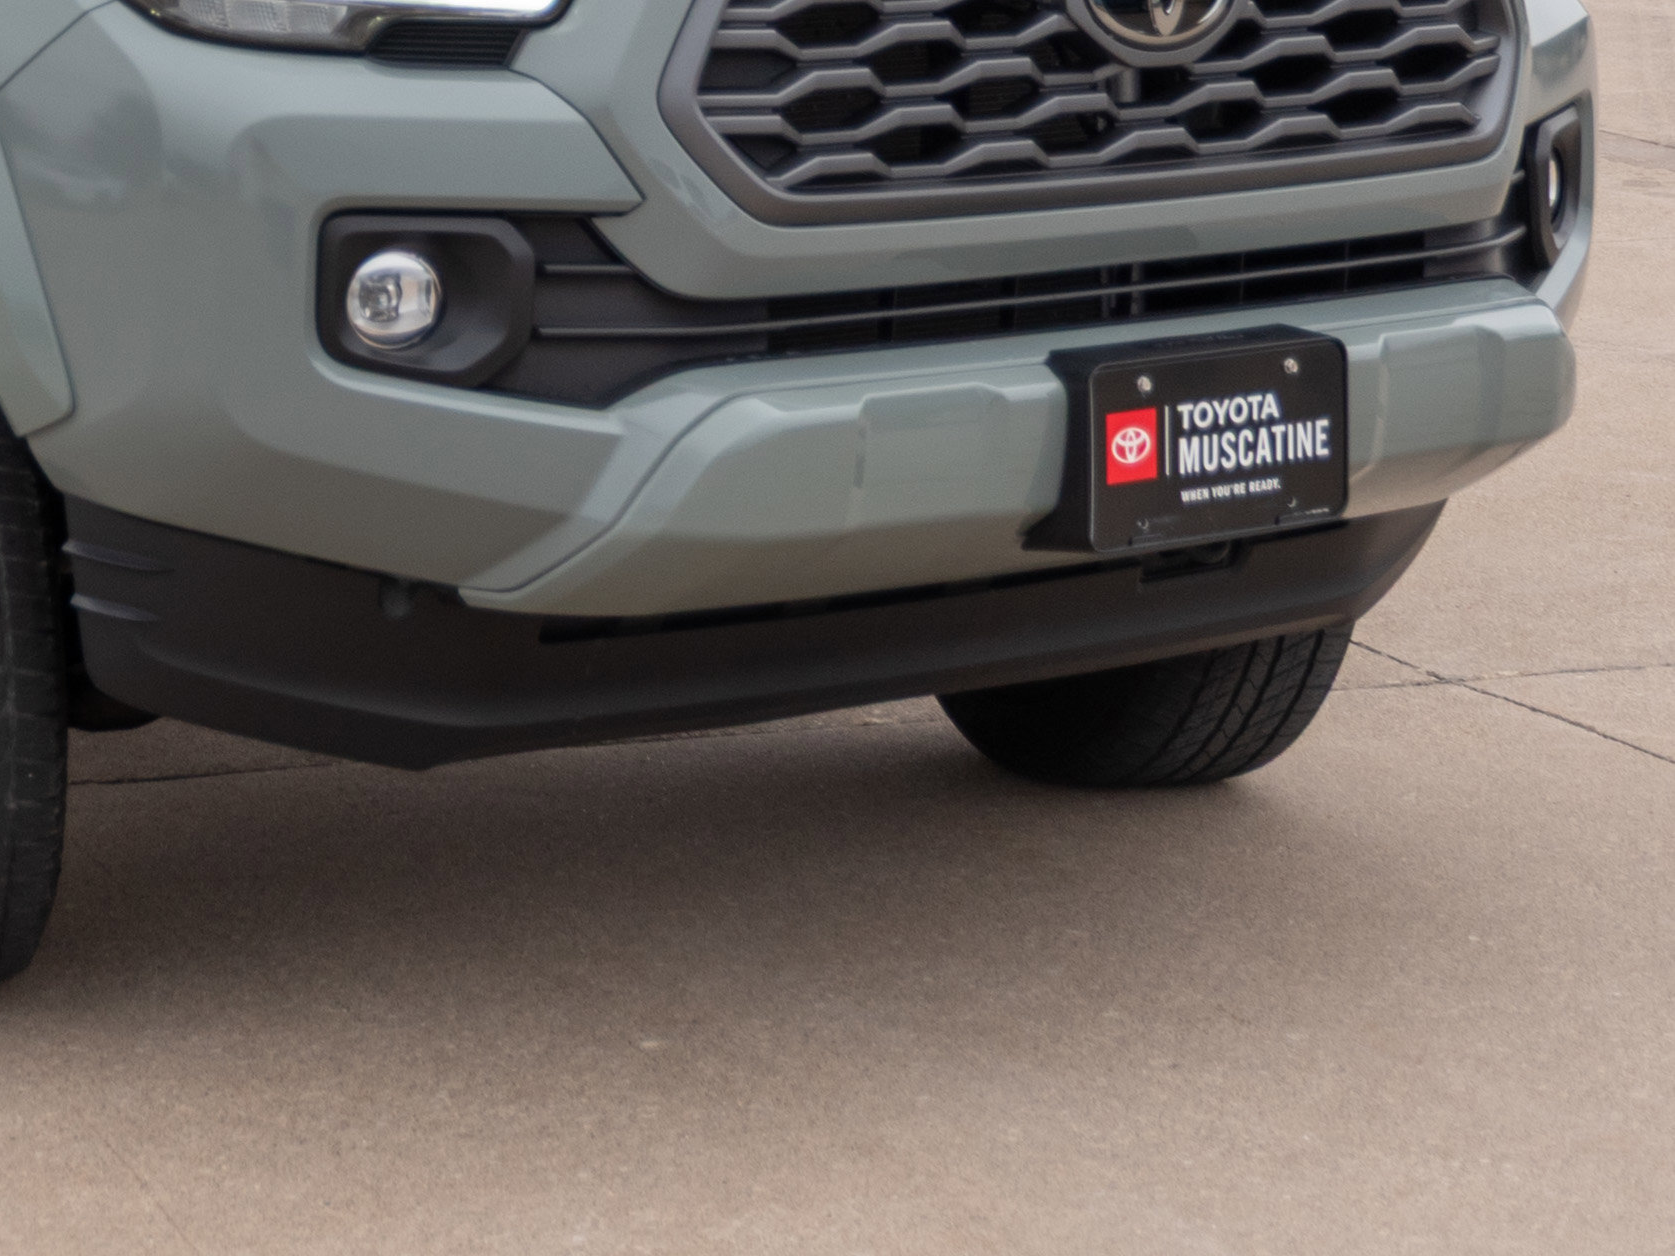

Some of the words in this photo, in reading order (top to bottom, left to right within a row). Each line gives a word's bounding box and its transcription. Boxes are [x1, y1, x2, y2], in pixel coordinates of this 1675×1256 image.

[1177, 393, 1280, 430] TOYOTA
[1178, 418, 1330, 475] MUSCATINE
[1180, 488, 1209, 503] WHEN
[1211, 482, 1246, 498] YOU'RE
[1249, 477, 1281, 493] READY.
